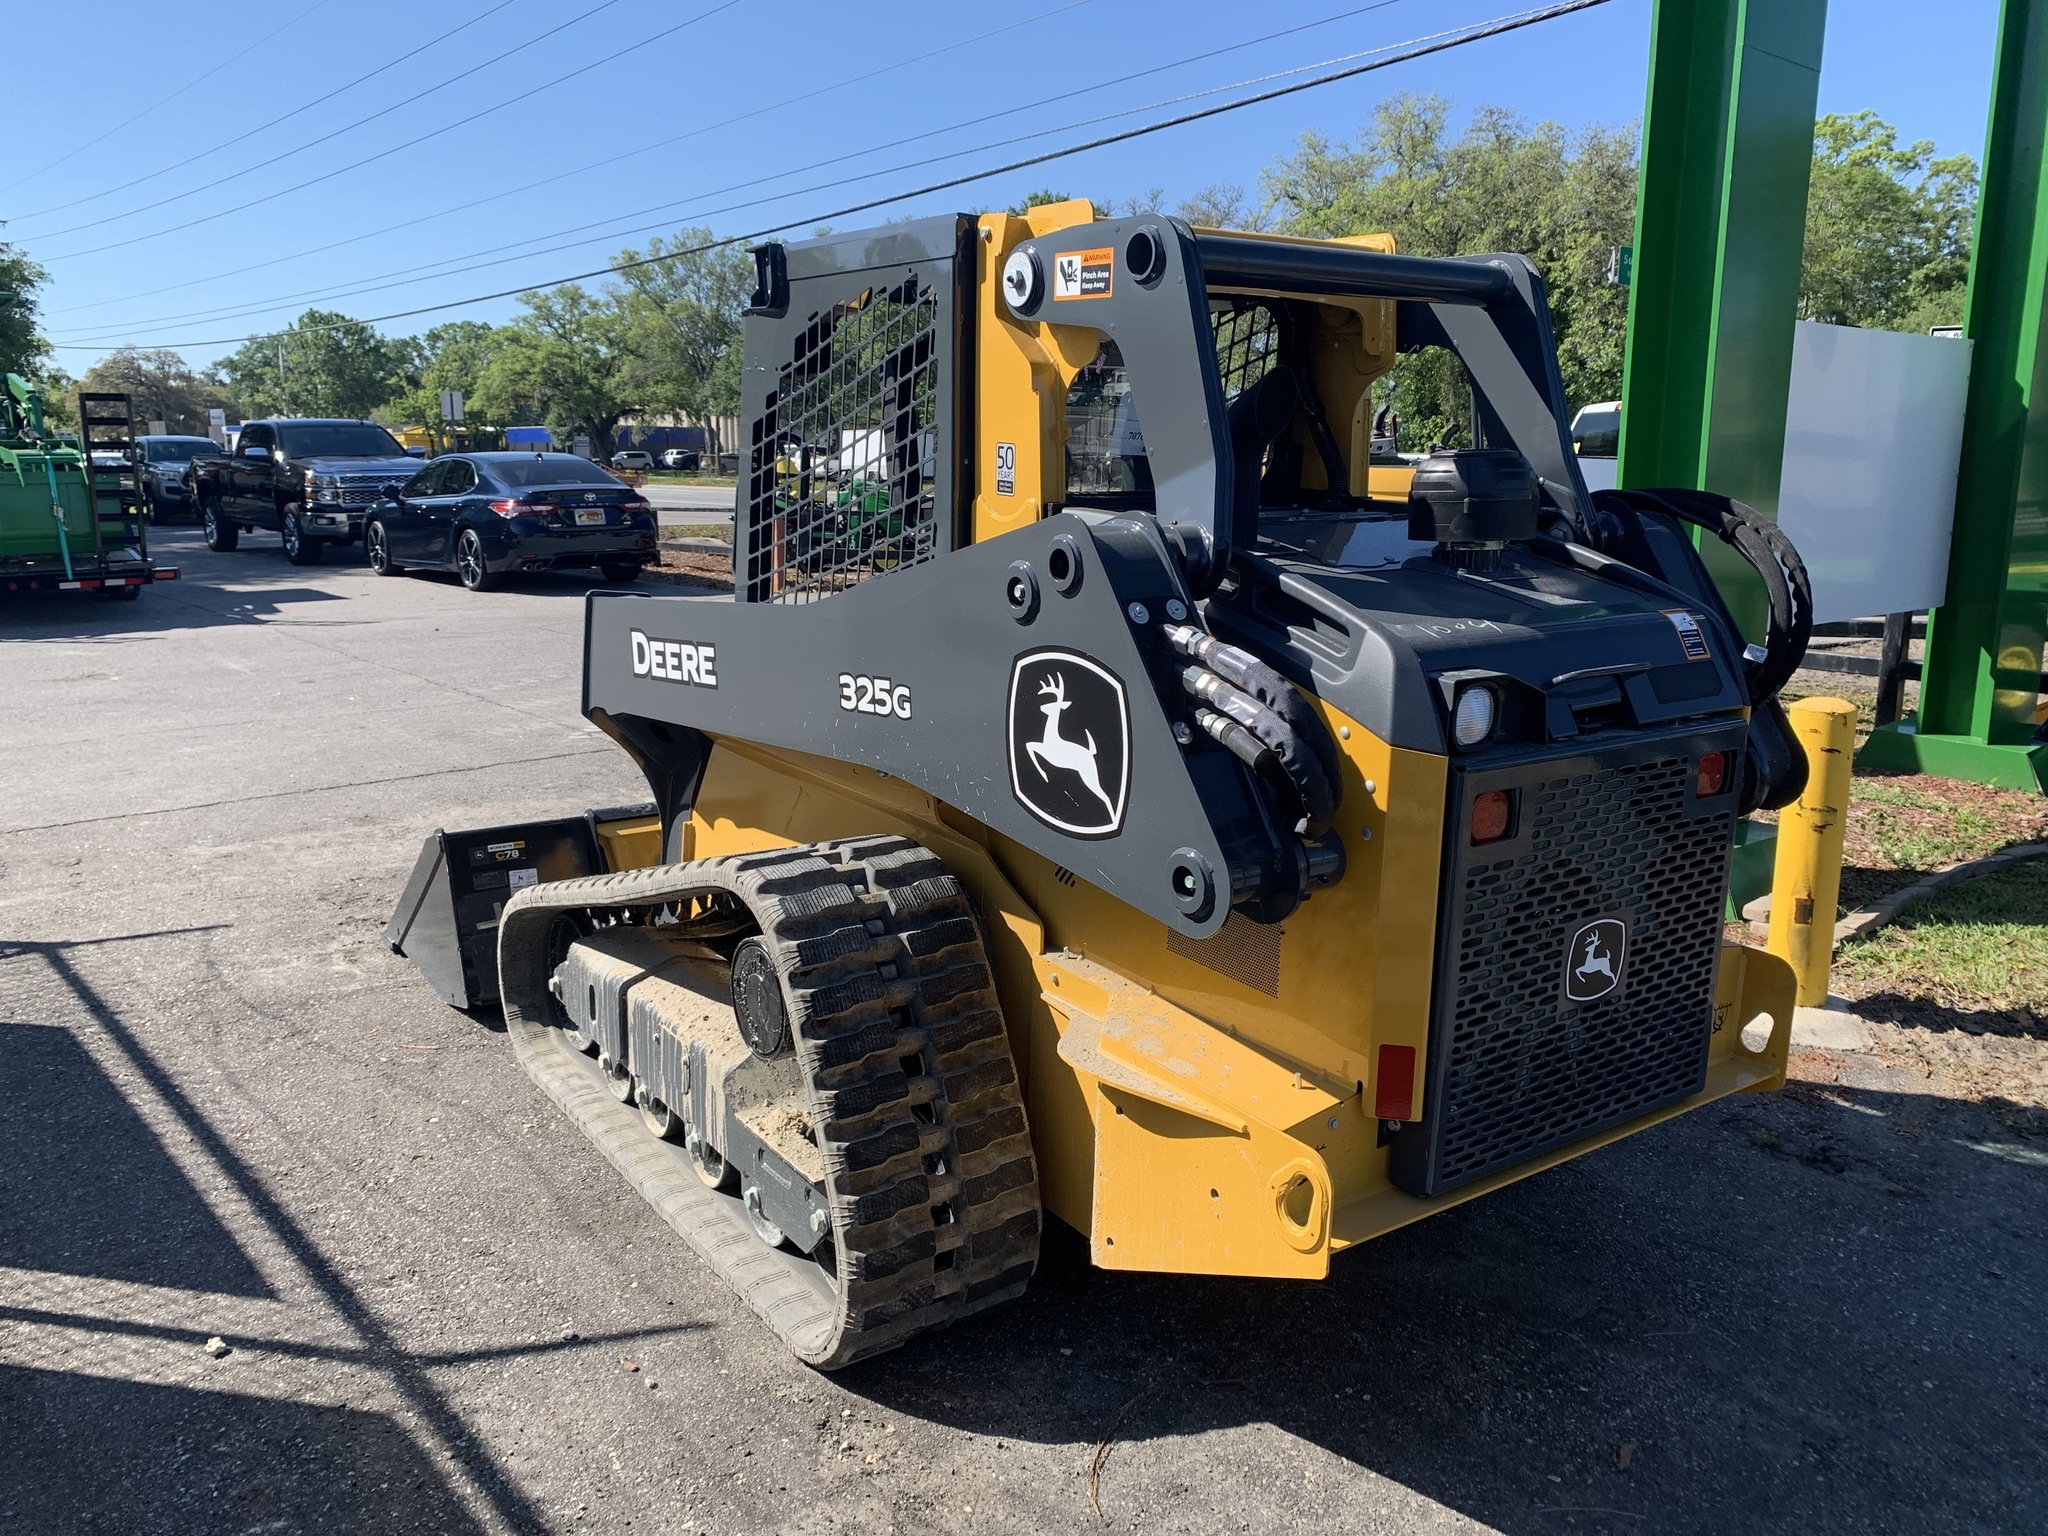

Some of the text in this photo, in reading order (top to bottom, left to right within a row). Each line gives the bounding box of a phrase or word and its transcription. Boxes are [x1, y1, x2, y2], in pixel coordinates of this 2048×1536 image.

[1088, 252, 1111, 262] WARNING
[1082, 270, 1110, 280] Pinch Area
[1081, 281, 1106, 290] Keep Away
[997, 445, 1014, 470] 50
[997, 470, 1014, 480] YEARS
[630, 631, 717, 686] DEERE
[838, 673, 912, 719] 325G
[495, 849, 520, 861] C78
